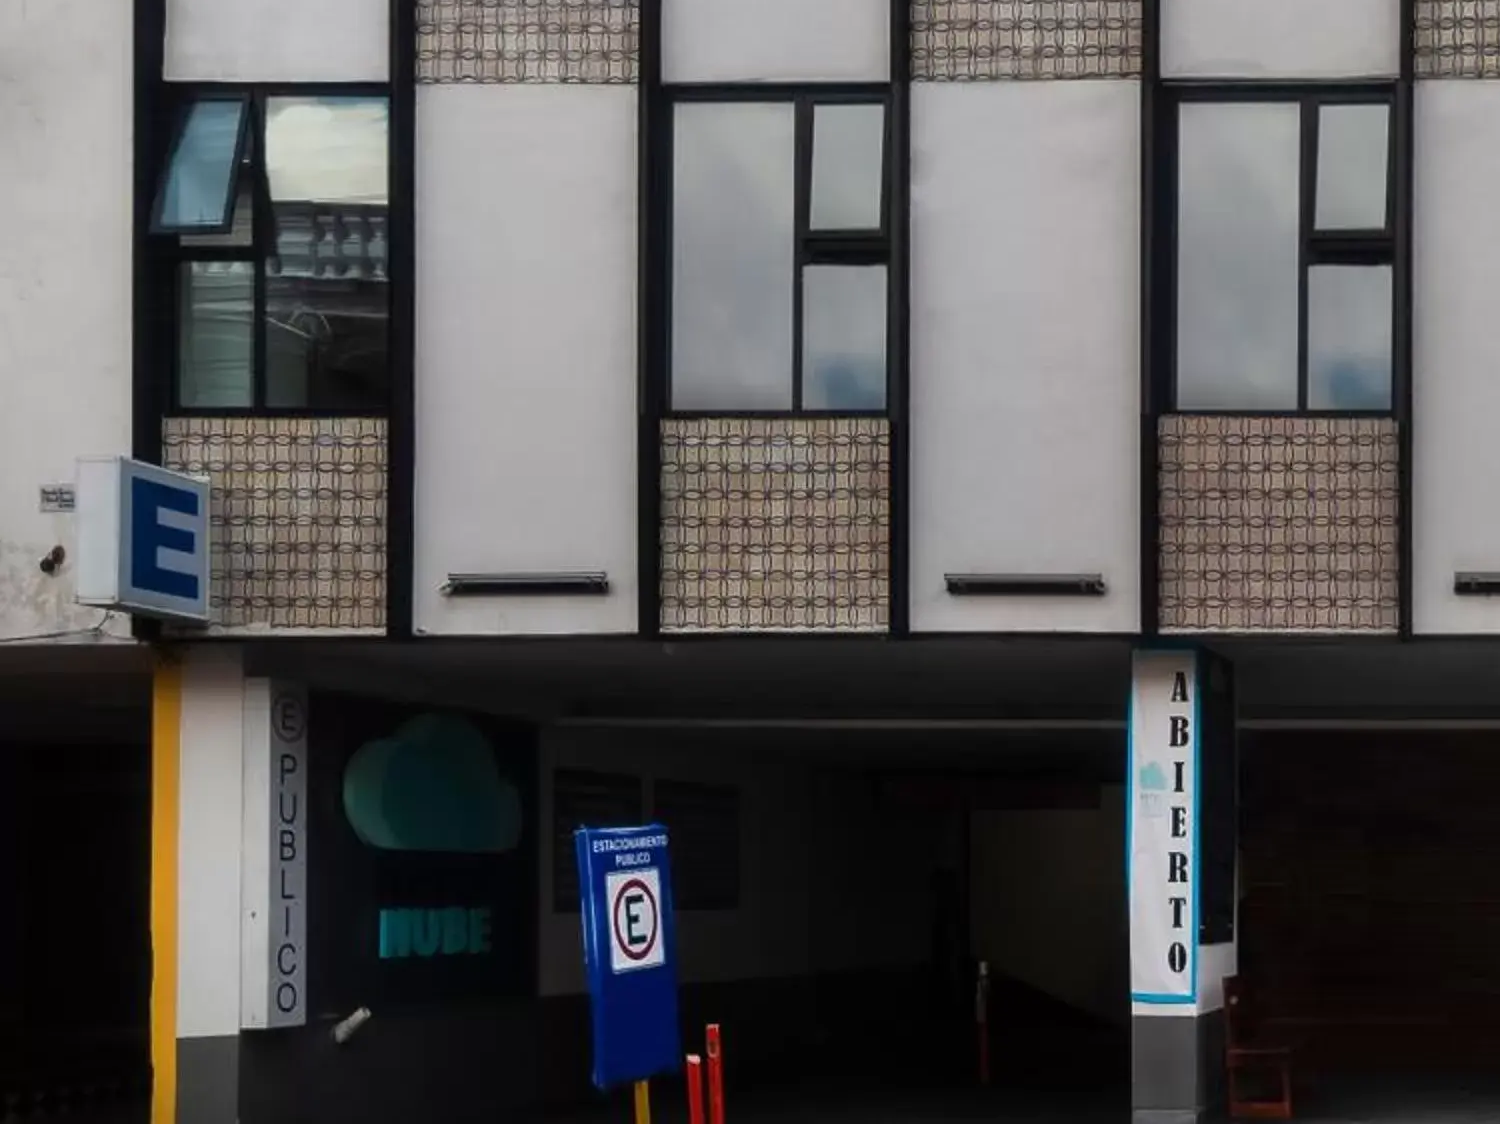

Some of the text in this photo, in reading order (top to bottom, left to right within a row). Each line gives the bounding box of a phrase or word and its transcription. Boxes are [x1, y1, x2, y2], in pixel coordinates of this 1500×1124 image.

[131, 476, 200, 600] E
[276, 697, 298, 1014] E PUBLICO
[593, 834, 669, 853] ESTACIONAMIENTO
[1167, 670, 1190, 974] ABIERTO
[378, 905, 493, 959] NUBE
[624, 894, 648, 946] E
